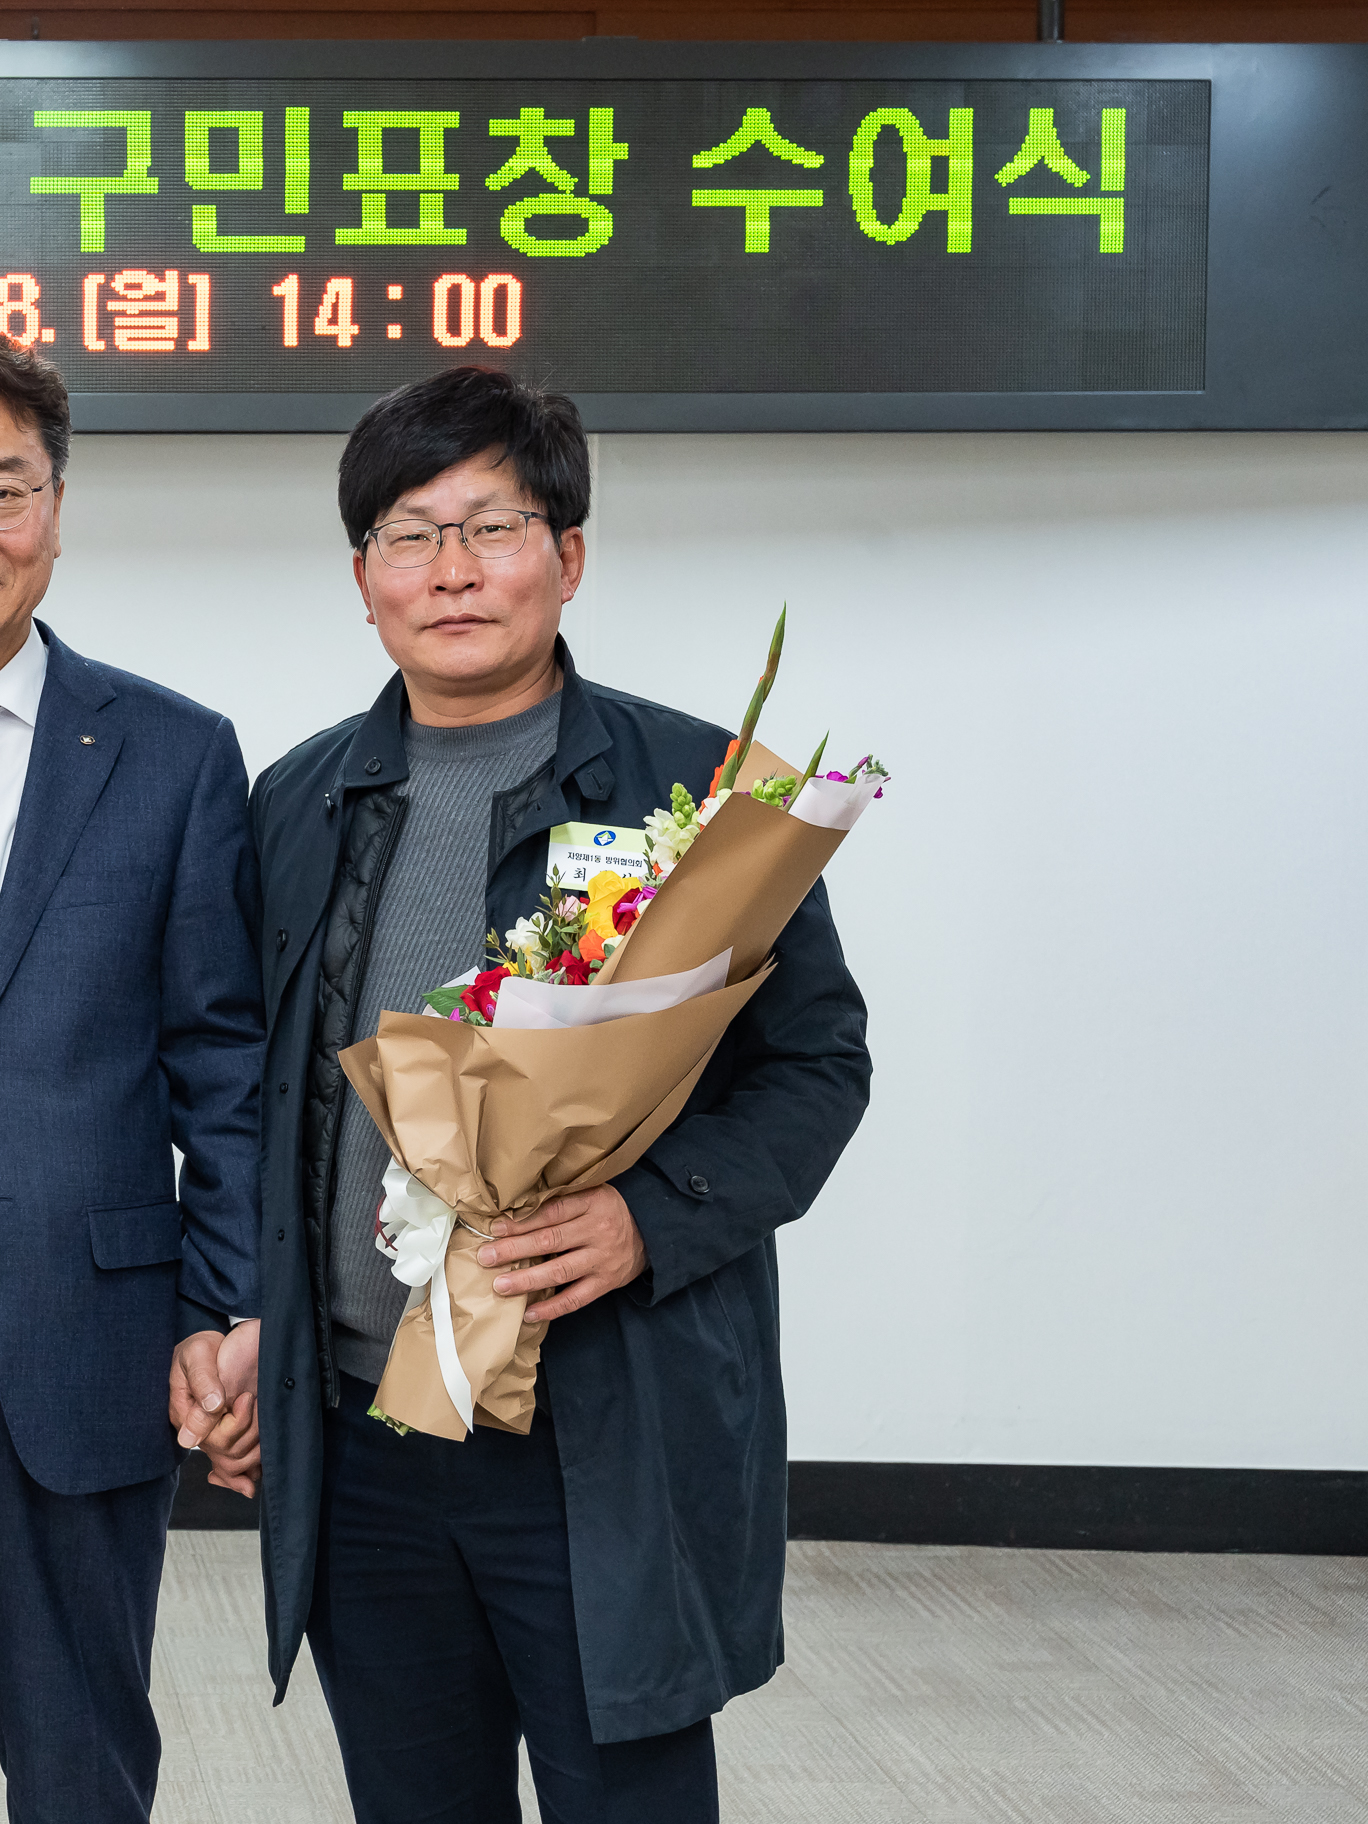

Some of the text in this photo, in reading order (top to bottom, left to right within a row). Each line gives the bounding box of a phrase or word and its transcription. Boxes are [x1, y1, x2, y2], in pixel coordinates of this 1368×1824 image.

[29, 106, 629, 257] 구민표창
[691, 107, 1126, 253] 수여식
[567, 851, 643, 868] 자양제1동 방위협의회
[573, 867, 587, 882] 최
